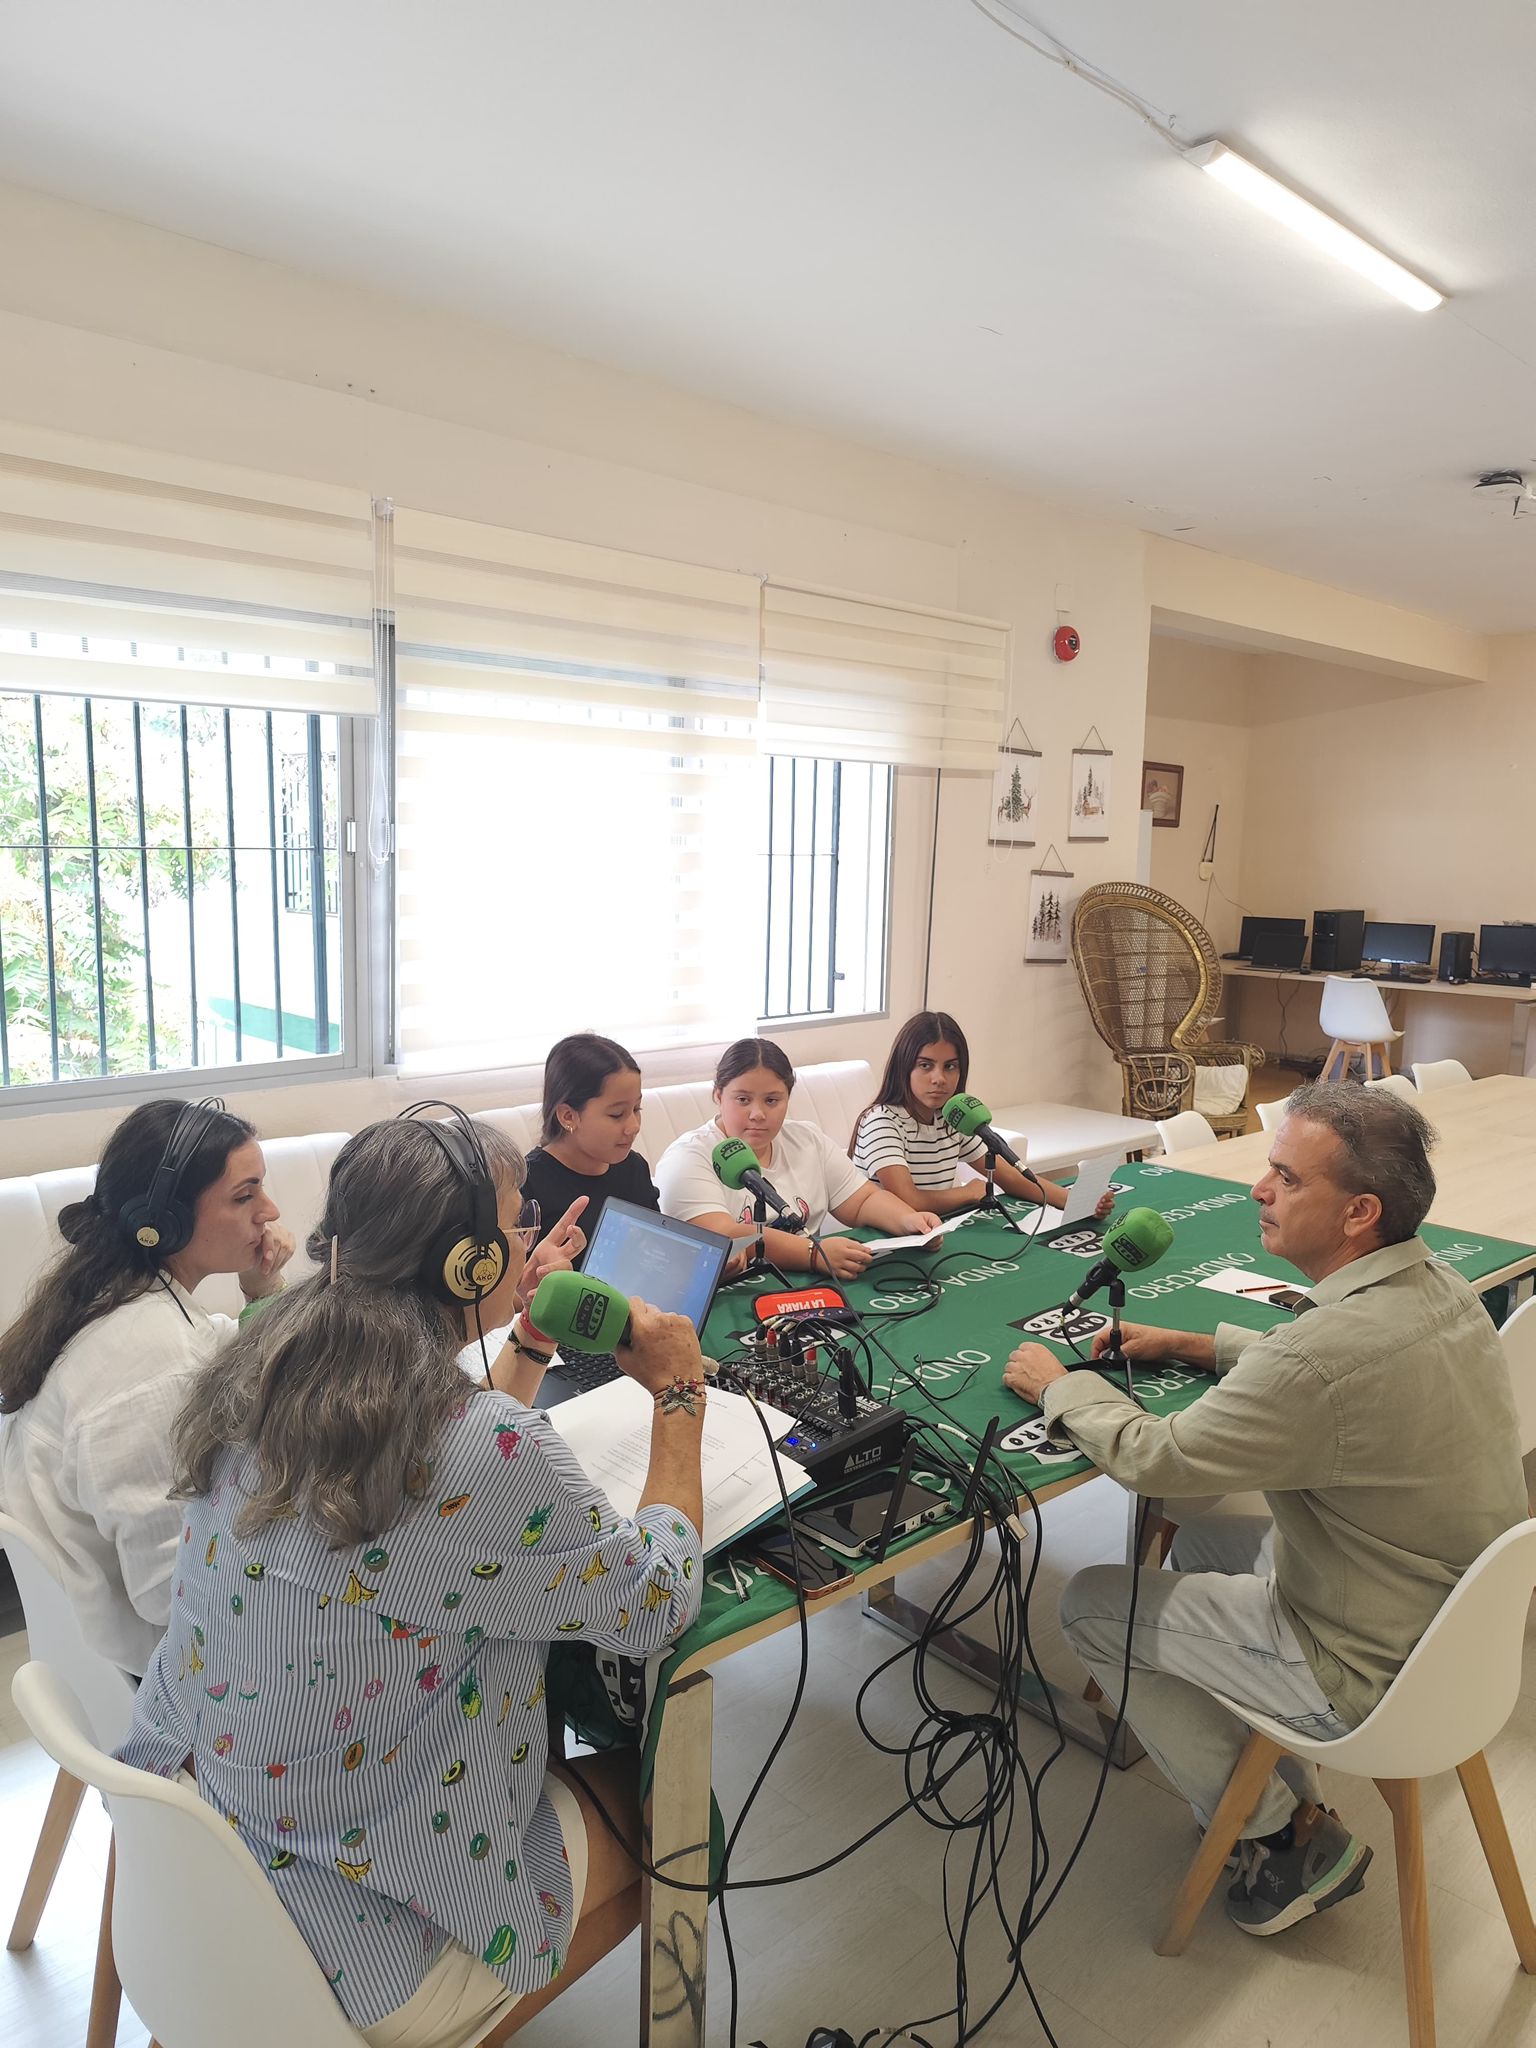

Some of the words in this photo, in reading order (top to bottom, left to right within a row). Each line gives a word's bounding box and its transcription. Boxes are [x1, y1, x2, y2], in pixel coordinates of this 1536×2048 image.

[1183, 1193, 1248, 1212] ONDA
[1160, 1208, 1196, 1223] CER
[1432, 1243, 1484, 1261] OND
[476, 1272, 496, 1282] AKG
[937, 1261, 1020, 1287] ONDA
[1181, 1252, 1257, 1278] ONDA
[869, 1283, 946, 1311] CERO
[1127, 1274, 1197, 1300] CERO
[589, 1300, 604, 1330] CERO
[777, 1300, 810, 1314] PIARA
[811, 1299, 826, 1309] LA
[888, 1350, 991, 1387] ONDA
[844, 1446, 882, 1470] ALTO
